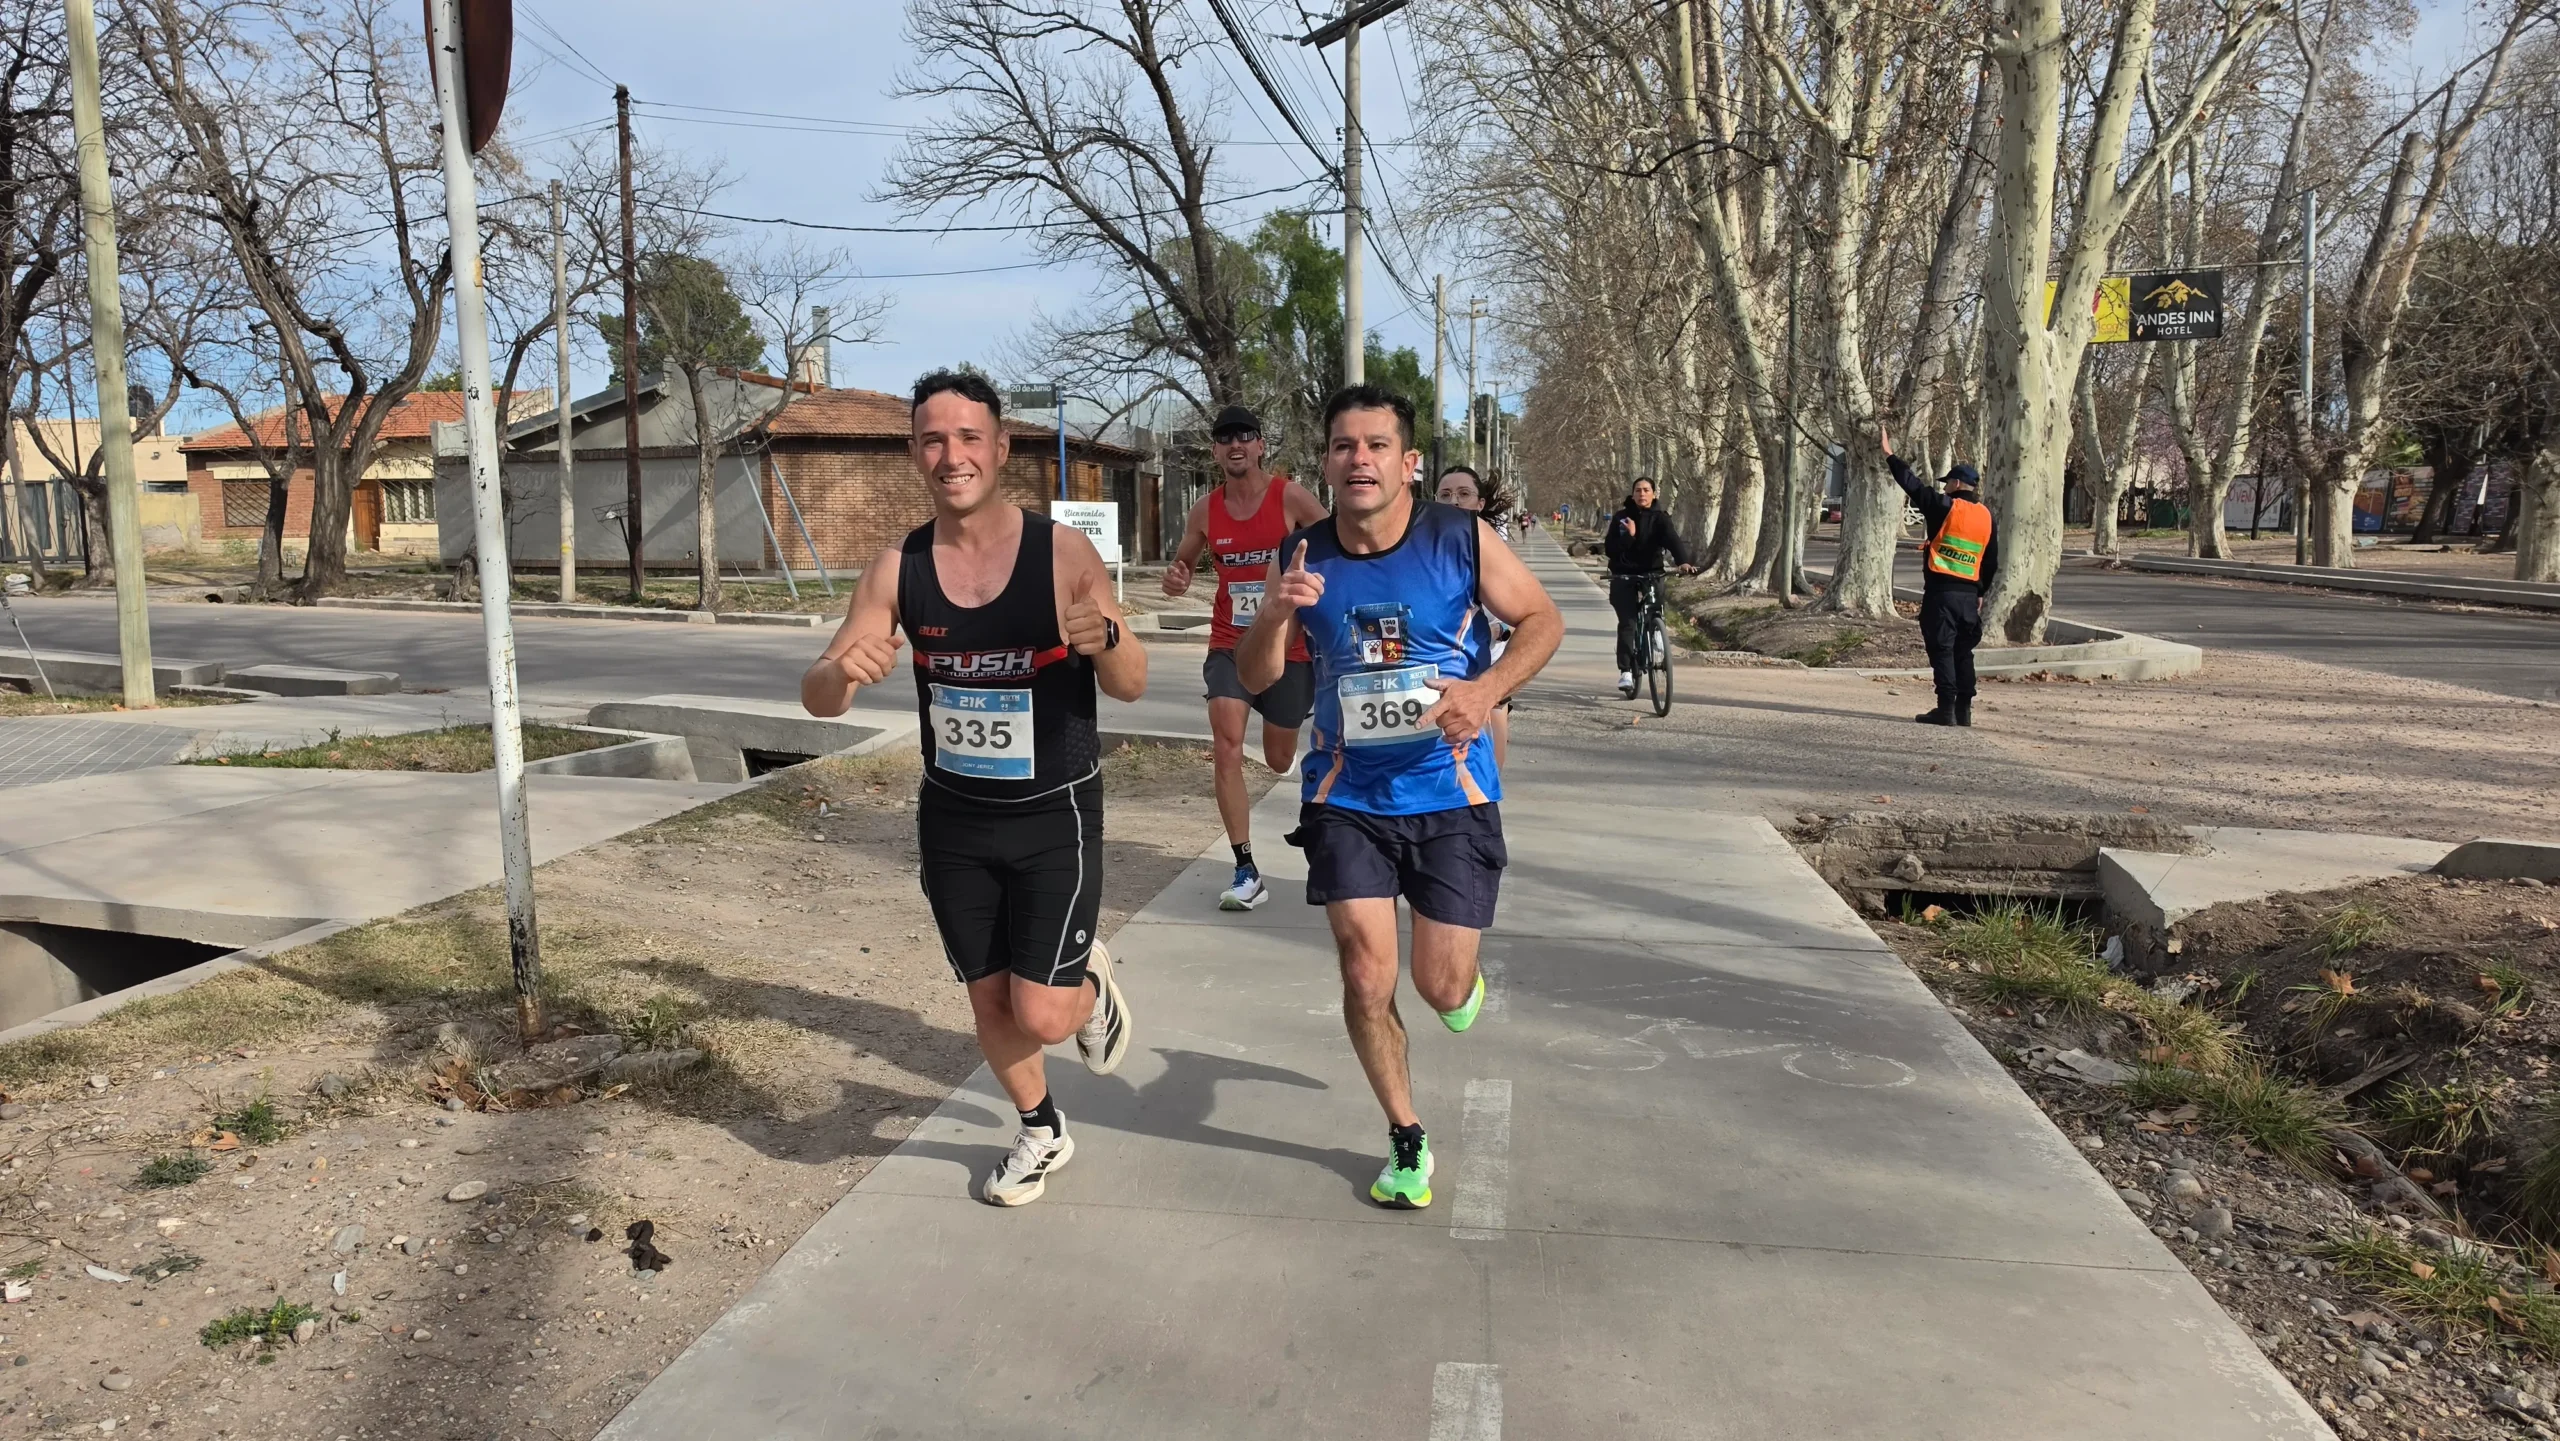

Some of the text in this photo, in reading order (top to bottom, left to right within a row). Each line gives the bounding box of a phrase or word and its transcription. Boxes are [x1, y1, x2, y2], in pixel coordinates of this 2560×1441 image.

[2137, 310, 2215, 326] ANDES INN
[2157, 326, 2193, 335] HOTEL
[1011, 384, 1052, 392] 20 de Junio
[1064, 509, 1106, 518] Bienvenidos
[1079, 527, 1103, 536] TER
[1222, 549, 1277, 563] PUSH
[1938, 546, 1976, 564] POLICIA
[1240, 596, 1262, 611] 21
[928, 650, 1034, 672] PUSH
[972, 667, 1035, 678] DEPORTIVA
[1373, 677, 1399, 690] 21K
[959, 696, 988, 708] 21K
[1360, 698, 1423, 730] 369
[945, 717, 1012, 750] 335
